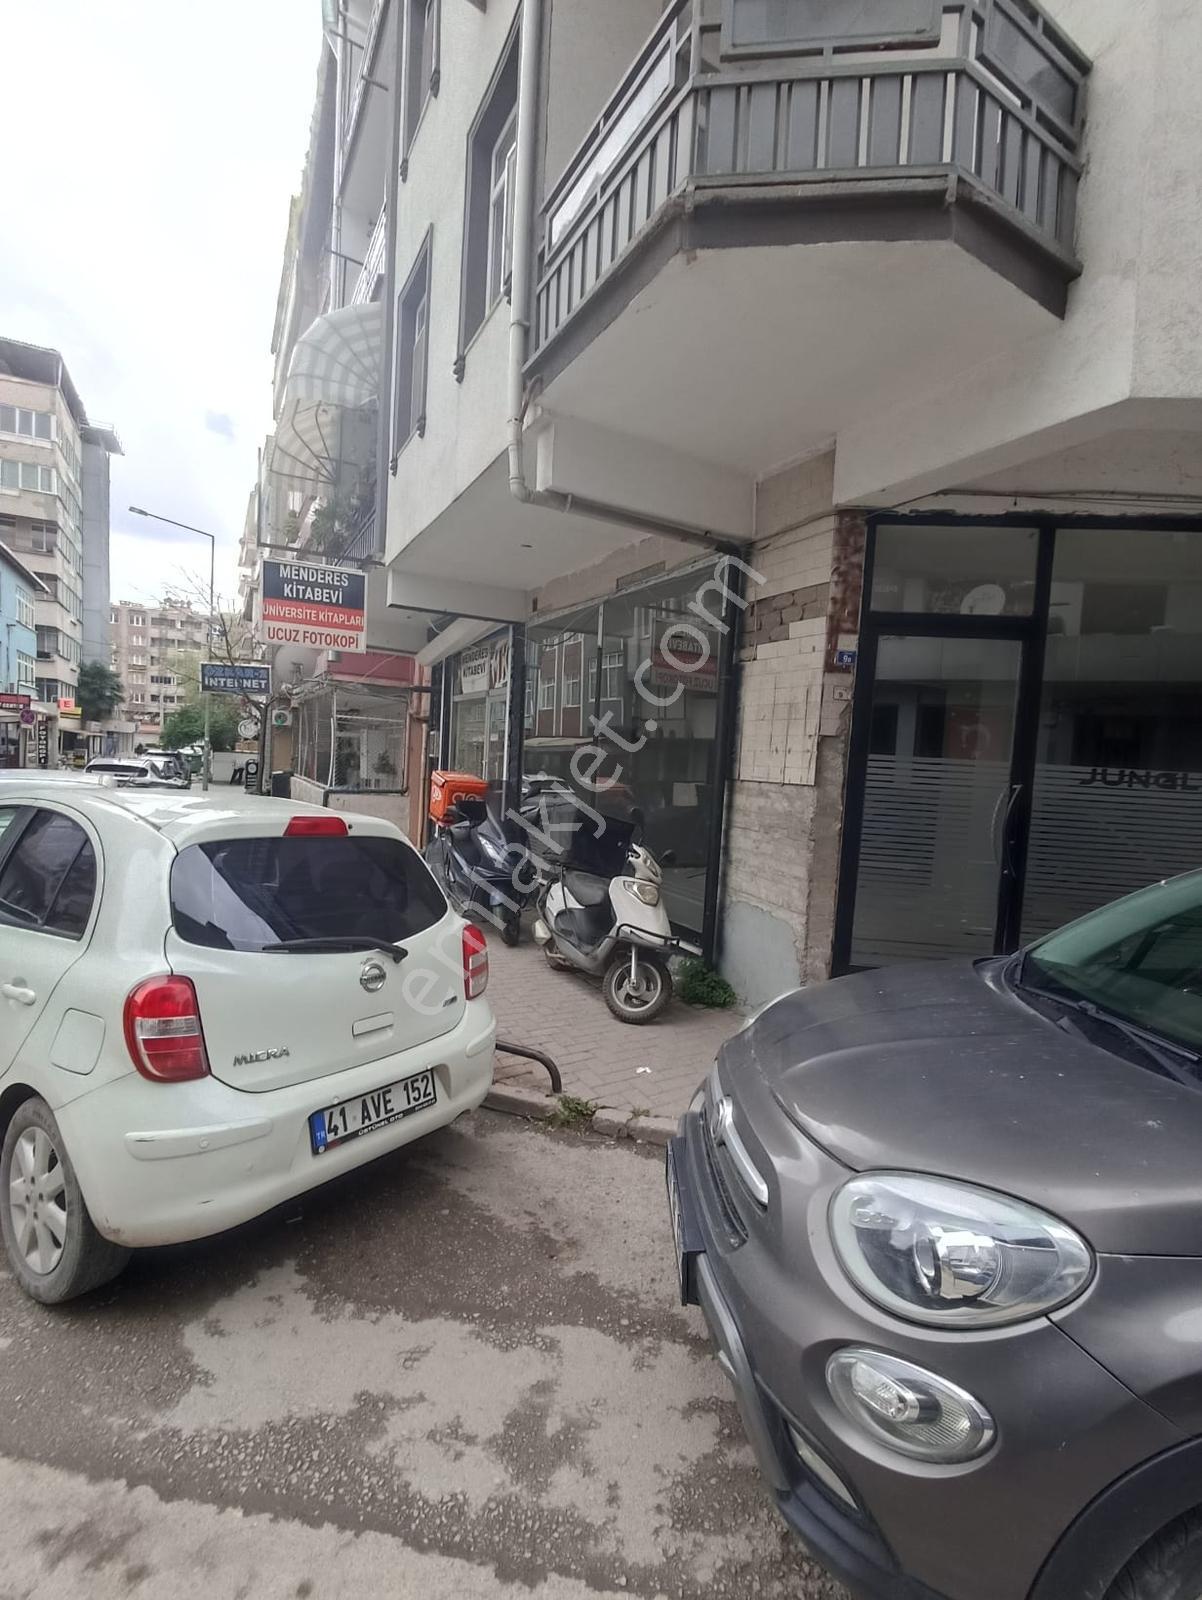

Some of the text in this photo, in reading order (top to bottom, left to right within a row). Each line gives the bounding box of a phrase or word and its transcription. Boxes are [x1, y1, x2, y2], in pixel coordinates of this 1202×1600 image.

[280, 564, 349, 587] MENDERES
[283, 581, 343, 604] KİTABEVİ
[267, 626, 359, 649] UCUZ FOTOKOPİ
[233, 1047, 290, 1067] MICRA
[327, 1106, 348, 1136] 41
[361, 1088, 395, 1126] AVE
[403, 1074, 432, 1106] 152
